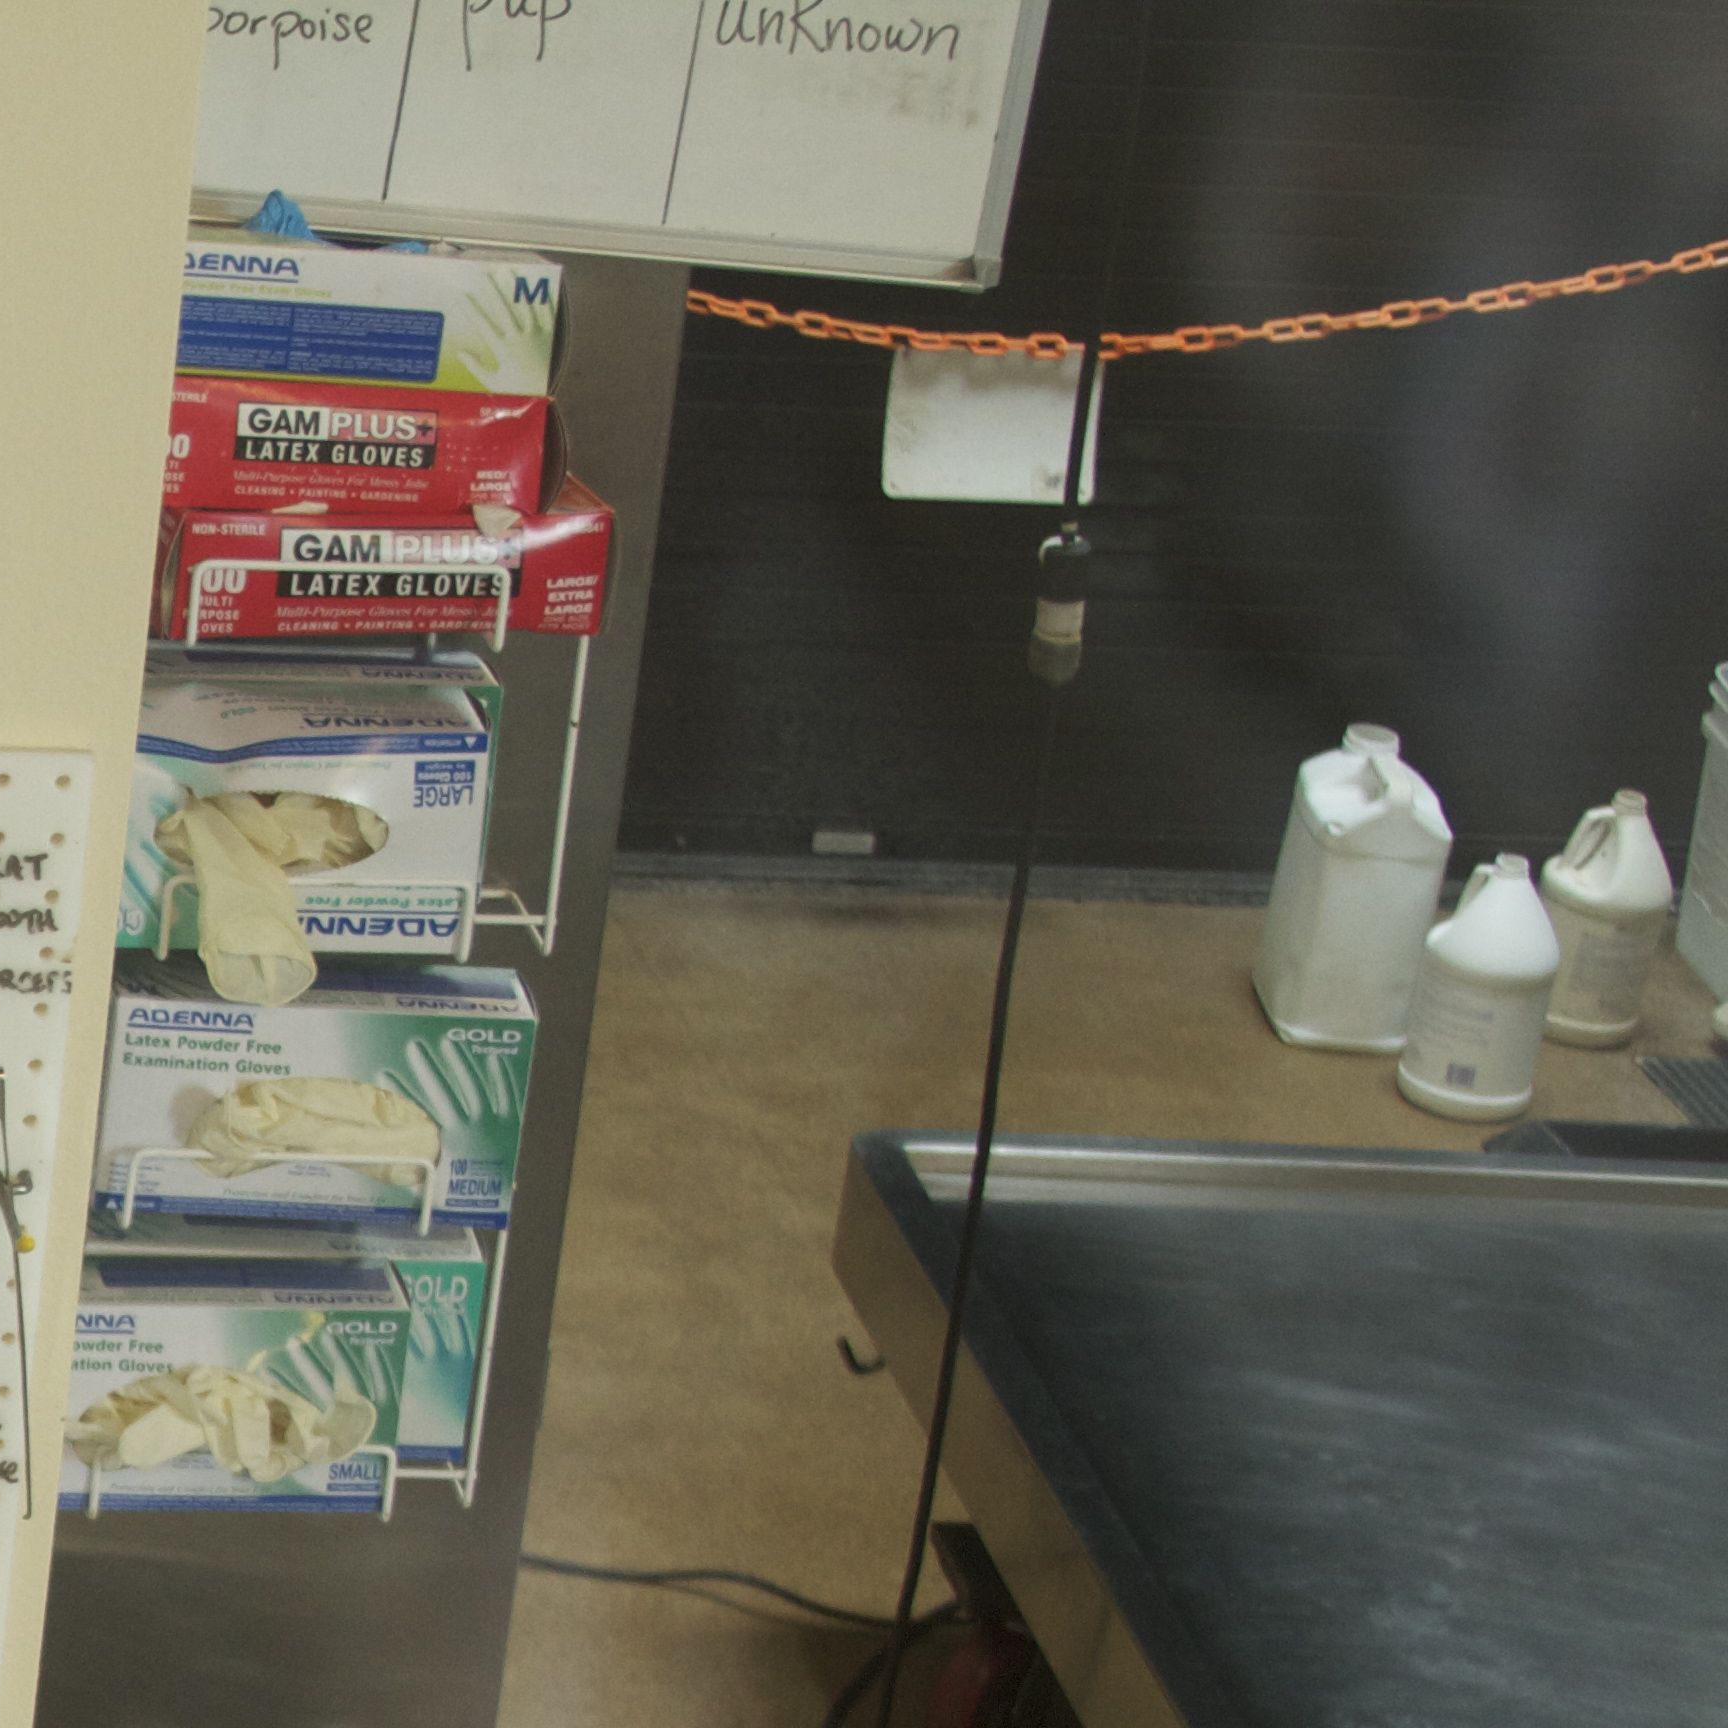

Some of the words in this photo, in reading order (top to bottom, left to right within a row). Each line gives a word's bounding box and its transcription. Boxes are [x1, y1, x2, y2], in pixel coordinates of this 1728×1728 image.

[513, 276, 550, 306] M
[247, 407, 321, 437] GAM
[245, 441, 320, 463] LATEX
[331, 444, 425, 468] GLOVES
[192, 522, 267, 537] NON-STERILE
[293, 533, 382, 563] GAM
[290, 572, 386, 597] LATEX
[395, 572, 507, 598] GLOVES
[547, 589, 594, 602] EXTRA
[544, 603, 594, 615] LARGE
[277, 621, 339, 632] CLEANING
[354, 620, 414, 631] PAINTING
[413, 786, 474, 807] LARGE
[297, 916, 459, 938] ADENN
[128, 1007, 255, 1029] ADENNA
[124, 1033, 171, 1048] Latex
[177, 1036, 241, 1053] Powder
[246, 1039, 283, 1055] Free
[447, 1028, 522, 1044] GOLD
[122, 1053, 229, 1073] Examination
[235, 1059, 291, 1076] Gloves
[448, 1178, 503, 1197] MEDIUM
[72, 1339, 125, 1354] owder
[128, 1340, 164, 1354] Free
[328, 1463, 382, 1481] SMALL
